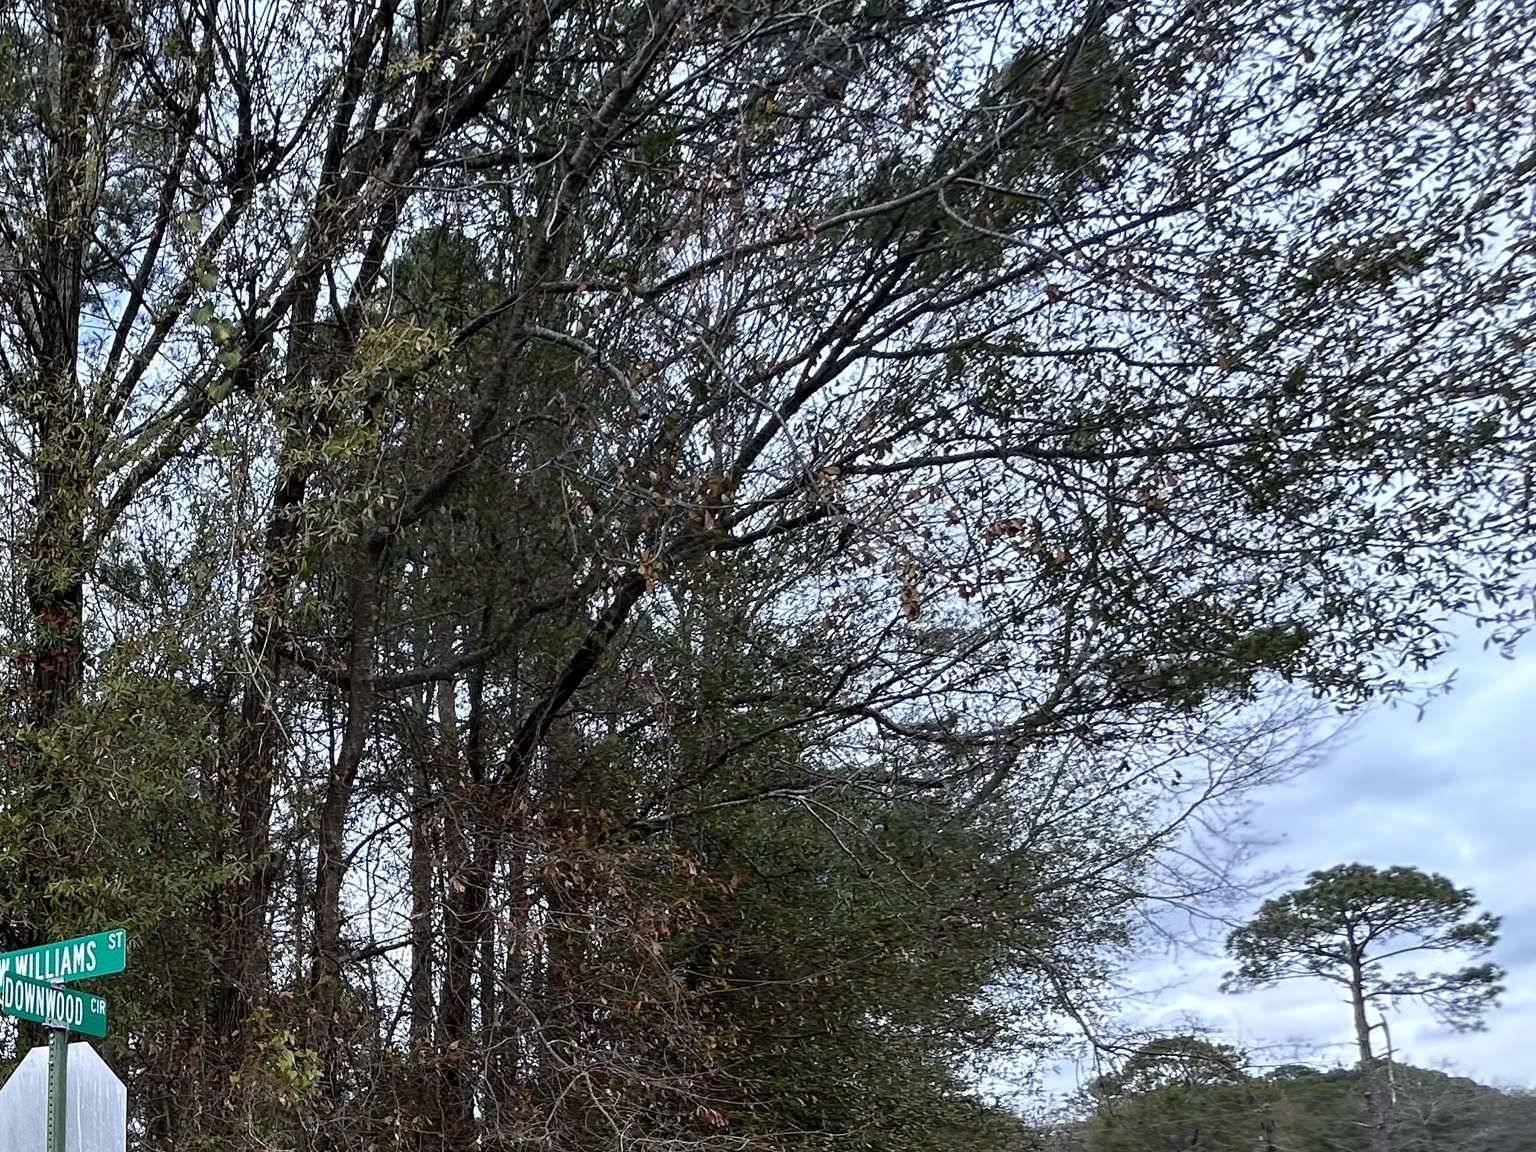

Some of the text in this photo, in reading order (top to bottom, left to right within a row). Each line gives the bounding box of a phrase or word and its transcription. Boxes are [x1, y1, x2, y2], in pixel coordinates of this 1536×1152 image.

[15, 940, 97, 981] WILLIAMS
[107, 931, 124, 950] ST
[4, 976, 106, 1026] DOWNWOOD CIR
